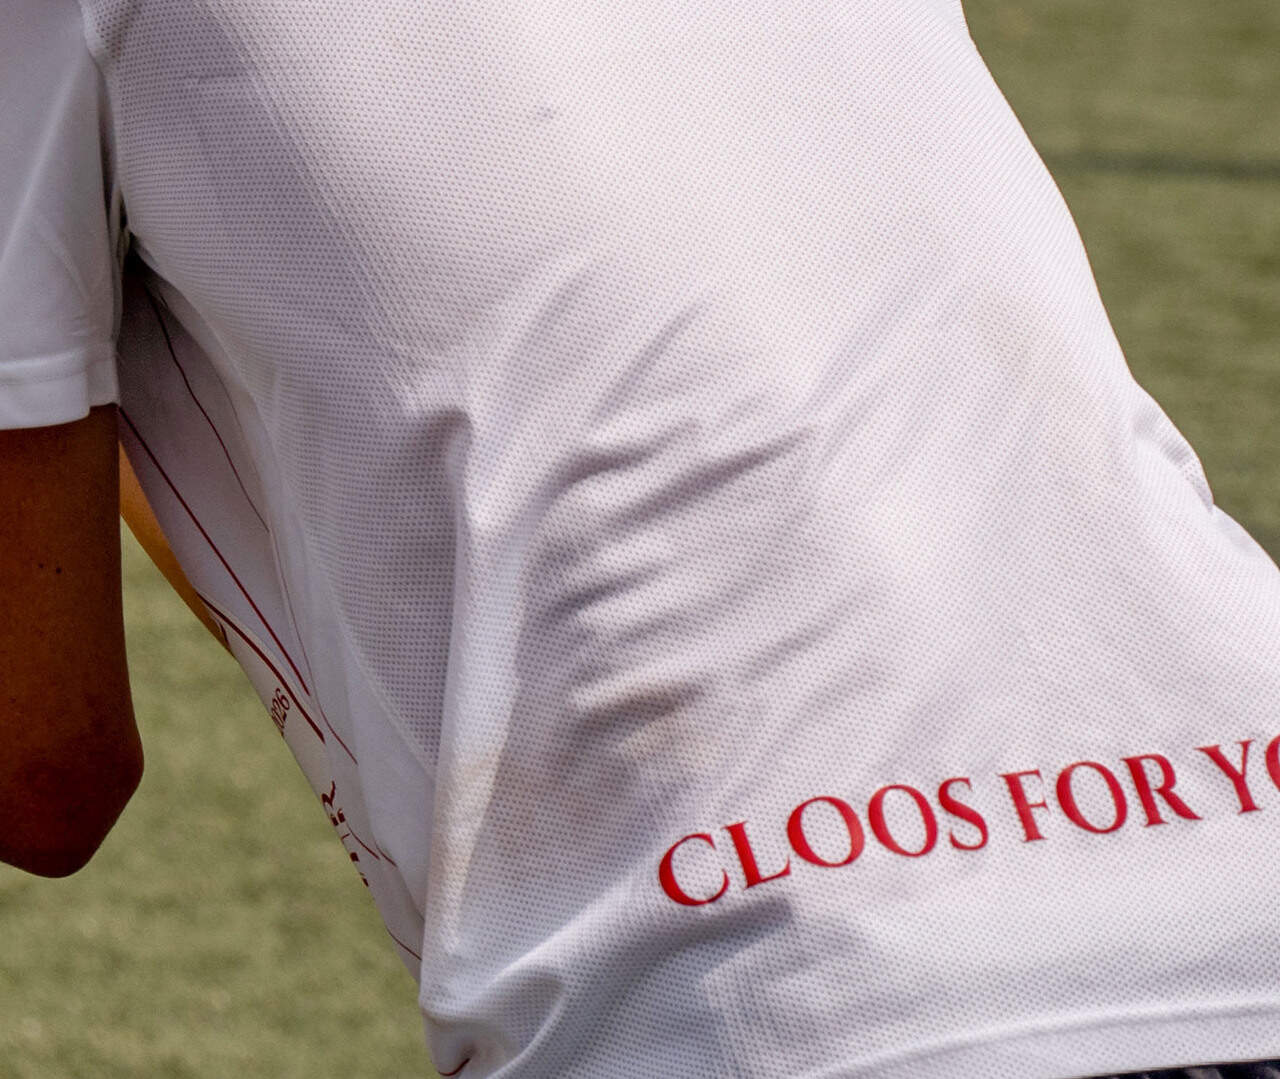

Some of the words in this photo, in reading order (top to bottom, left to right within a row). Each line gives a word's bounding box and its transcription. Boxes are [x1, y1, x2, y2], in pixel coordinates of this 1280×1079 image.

[658, 777, 989, 906] CLOOS
[1000, 753, 1203, 842] FOR
[1193, 733, 1280, 816] Y
